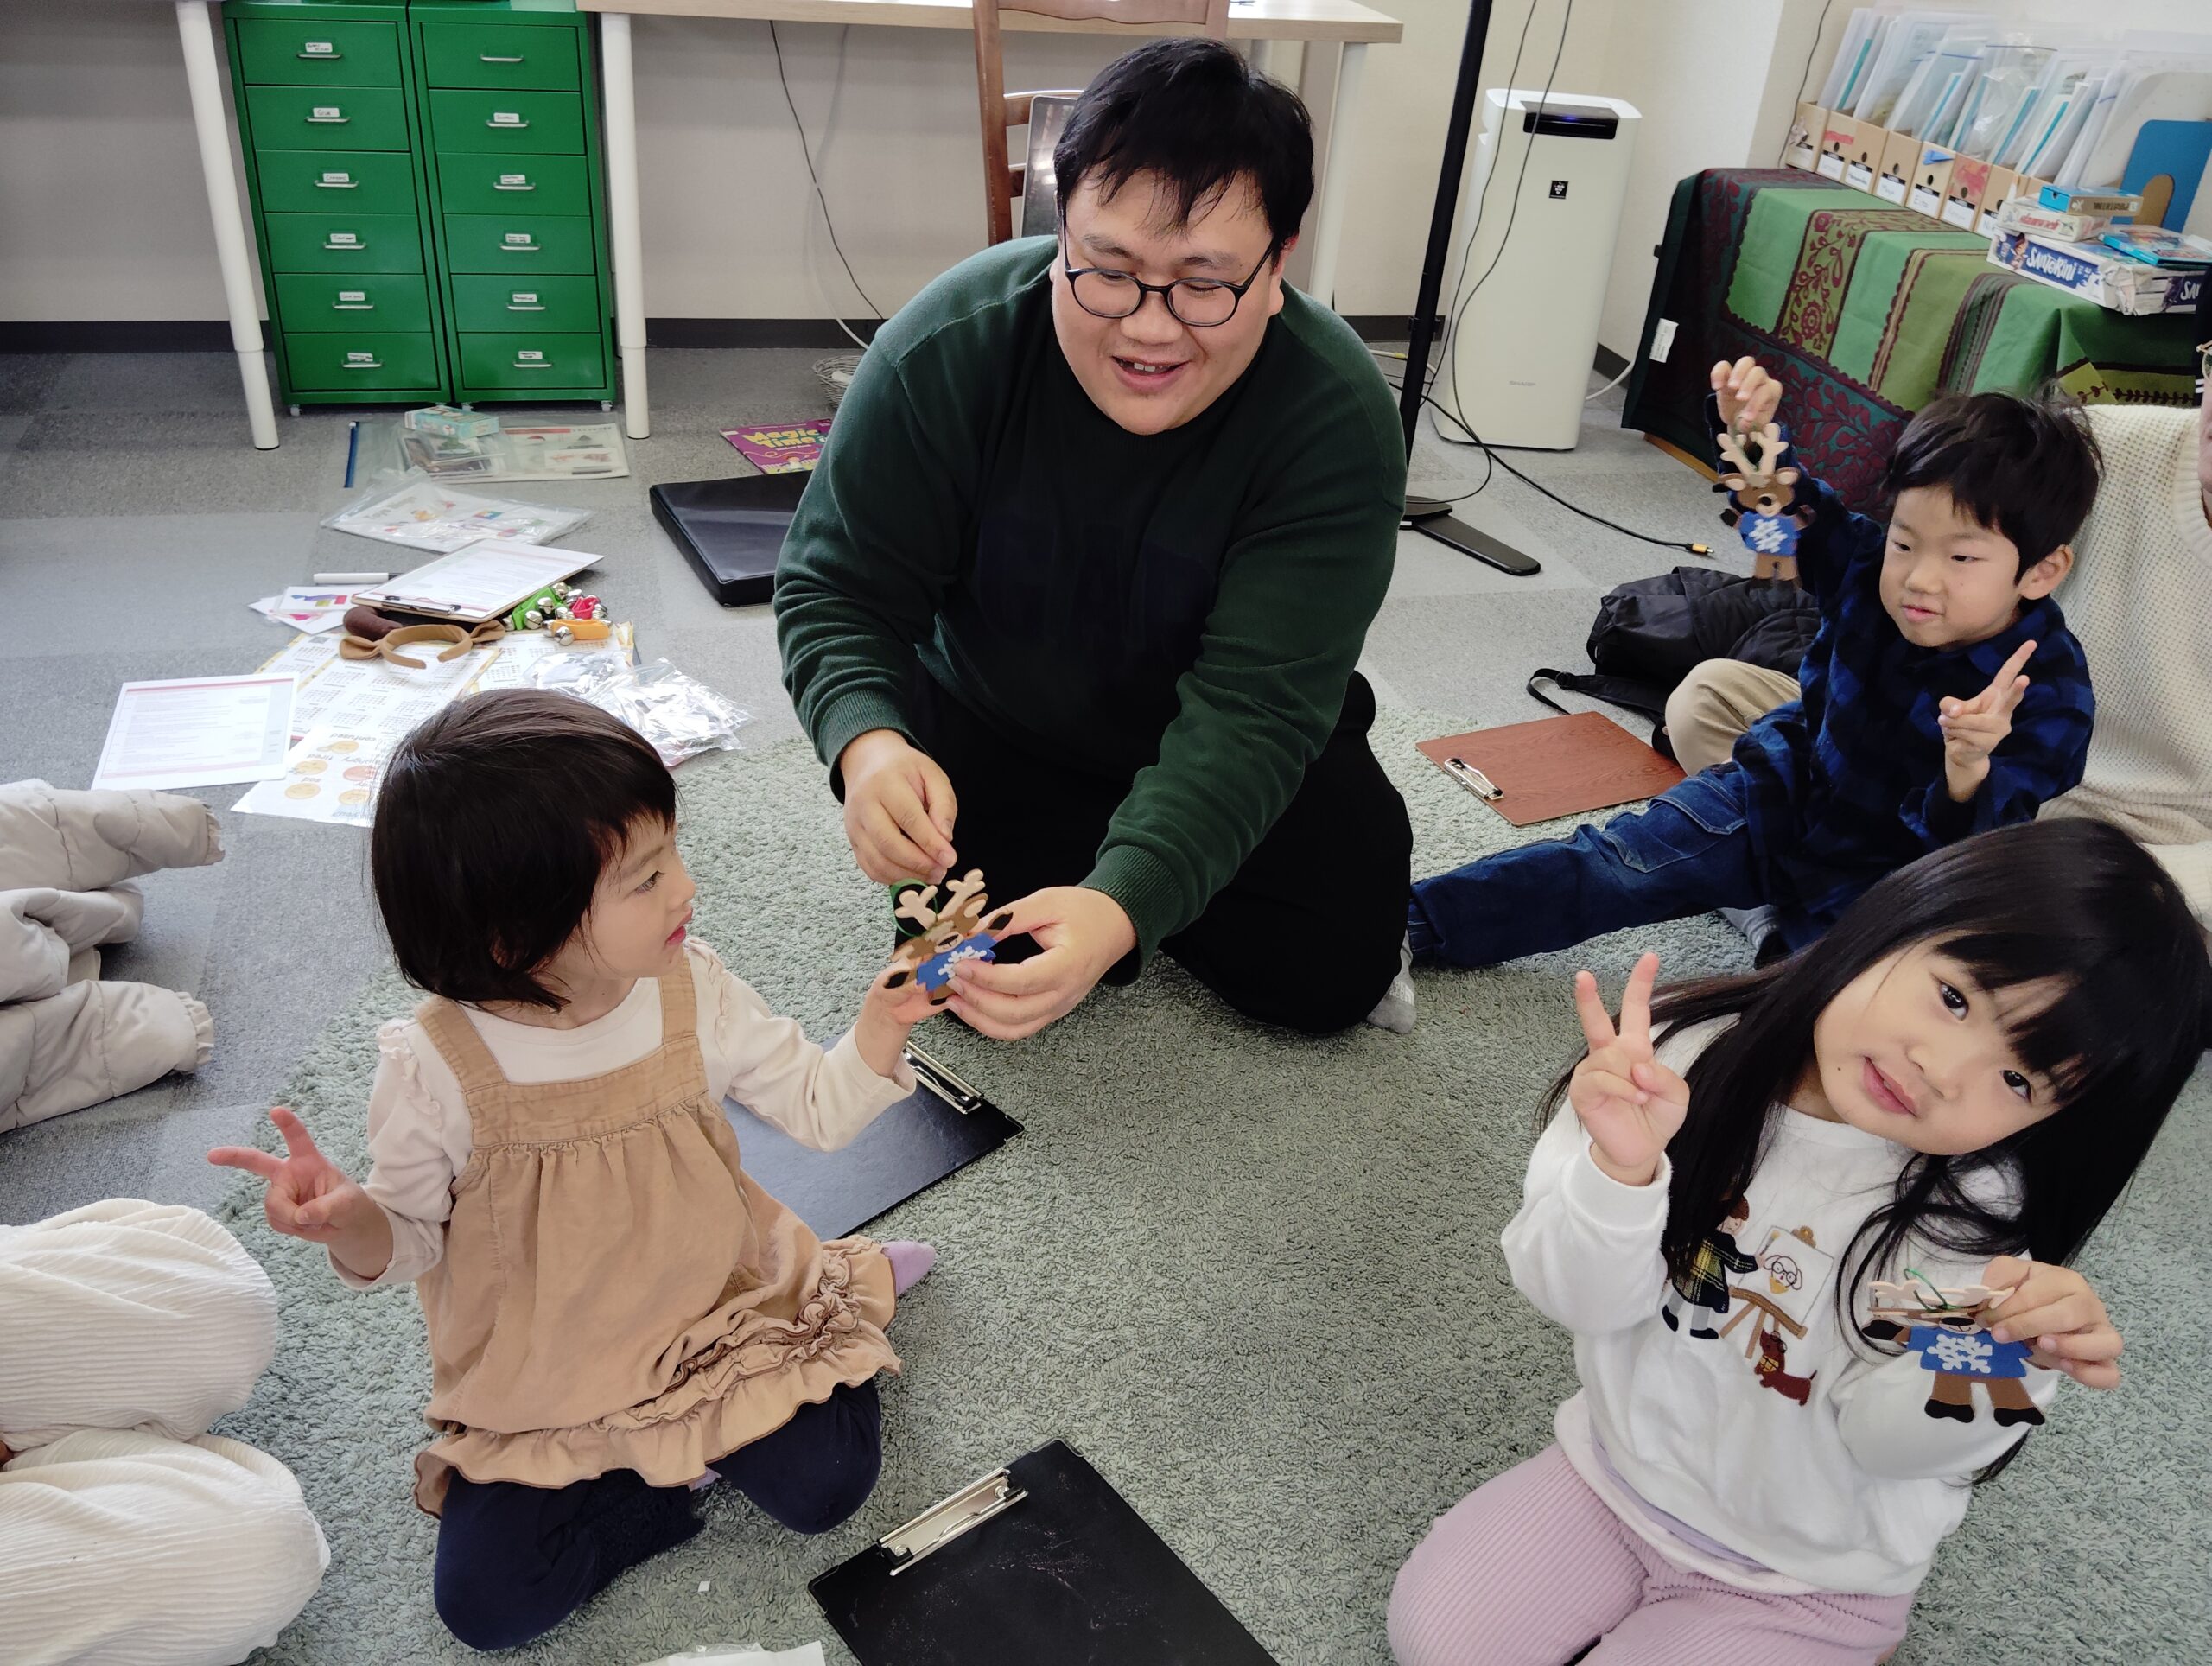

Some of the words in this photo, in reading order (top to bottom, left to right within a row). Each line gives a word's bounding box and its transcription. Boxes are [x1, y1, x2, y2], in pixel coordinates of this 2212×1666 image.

[741, 429, 820, 443] Magic
[756, 437, 817, 448] Time
[329, 732, 377, 741] confused
